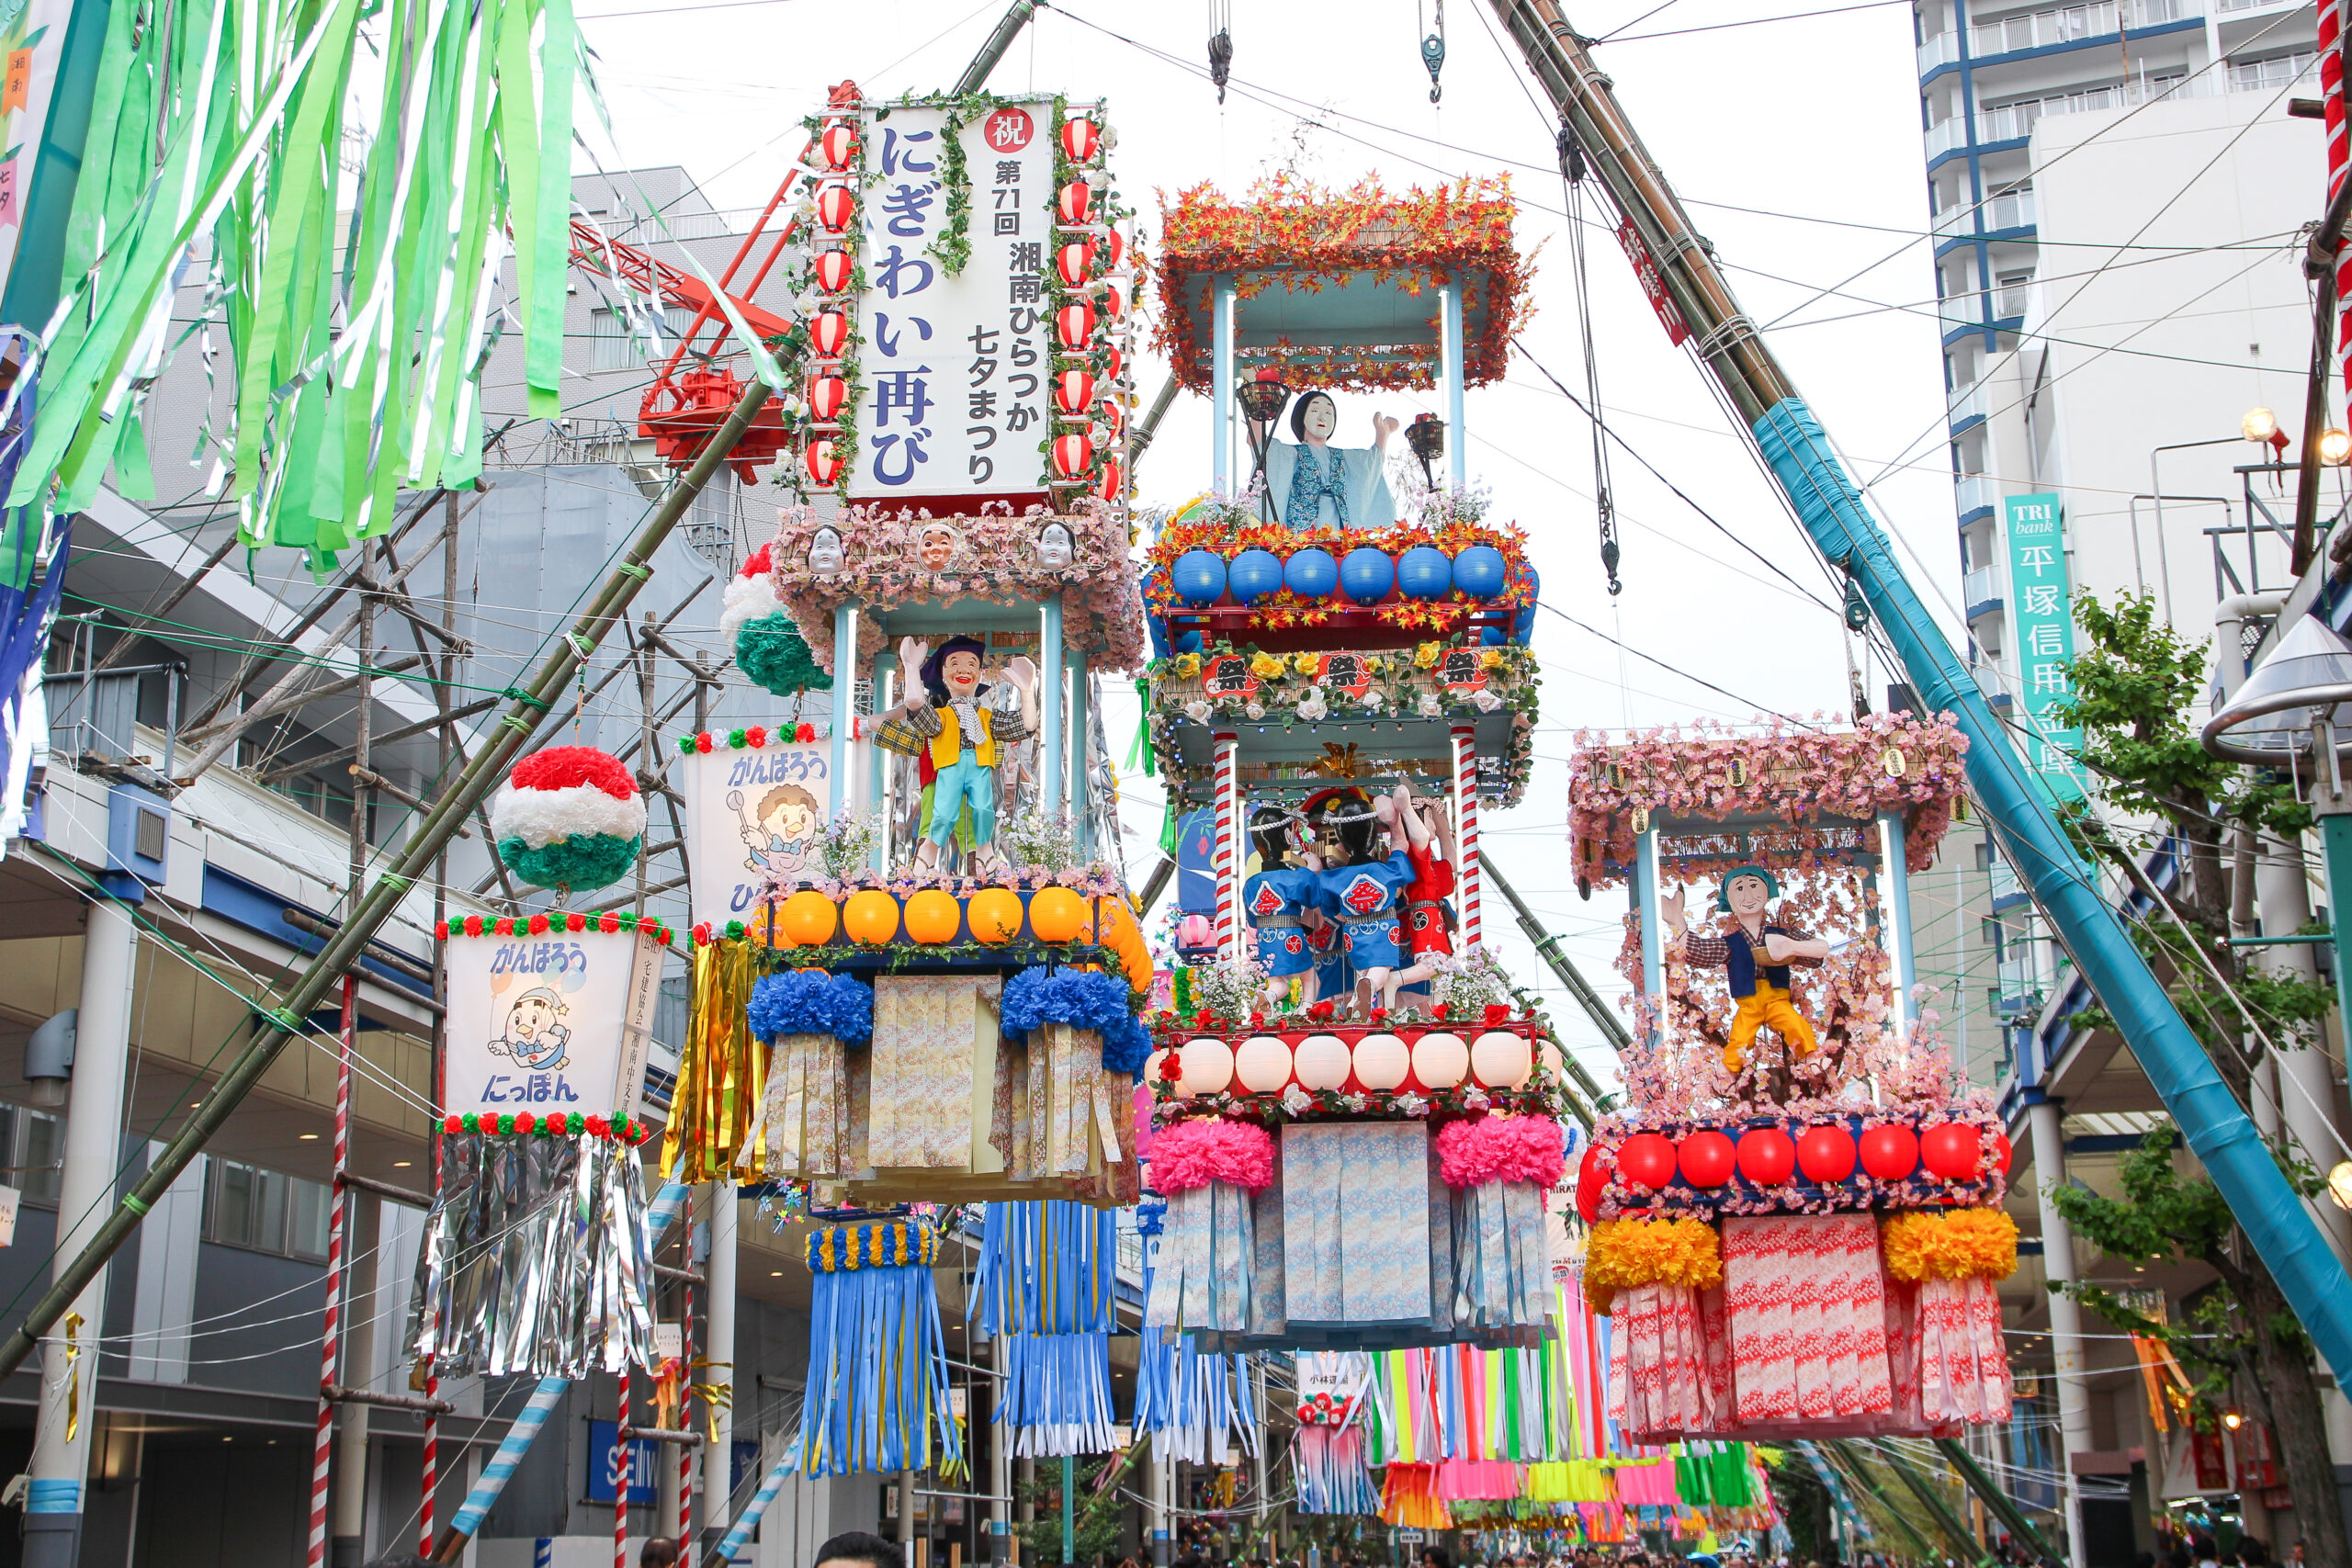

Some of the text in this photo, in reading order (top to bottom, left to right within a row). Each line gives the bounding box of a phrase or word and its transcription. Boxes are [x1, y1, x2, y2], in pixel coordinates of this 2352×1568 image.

[991, 114, 1026, 149] 祝
[991, 160, 1022, 237] 第71回
[868, 127, 941, 486] にぎわい再び
[1006, 242, 1041, 432] 湘南ひらつか
[967, 324, 1001, 485] 七夕まつり
[2012, 503, 2052, 522] TRI
[2015, 519, 2054, 536] bank
[1216, 659, 1248, 691] 祭
[1326, 654, 1358, 690] 祭
[1444, 650, 1476, 683] 祭
[2019, 545, 2076, 774] 平塚信用金庫
[728, 750, 827, 786] がんばろう
[1347, 880, 1383, 914] 祭
[489, 942, 587, 974] がんばろう
[480, 1072, 579, 1103] にっぽん
